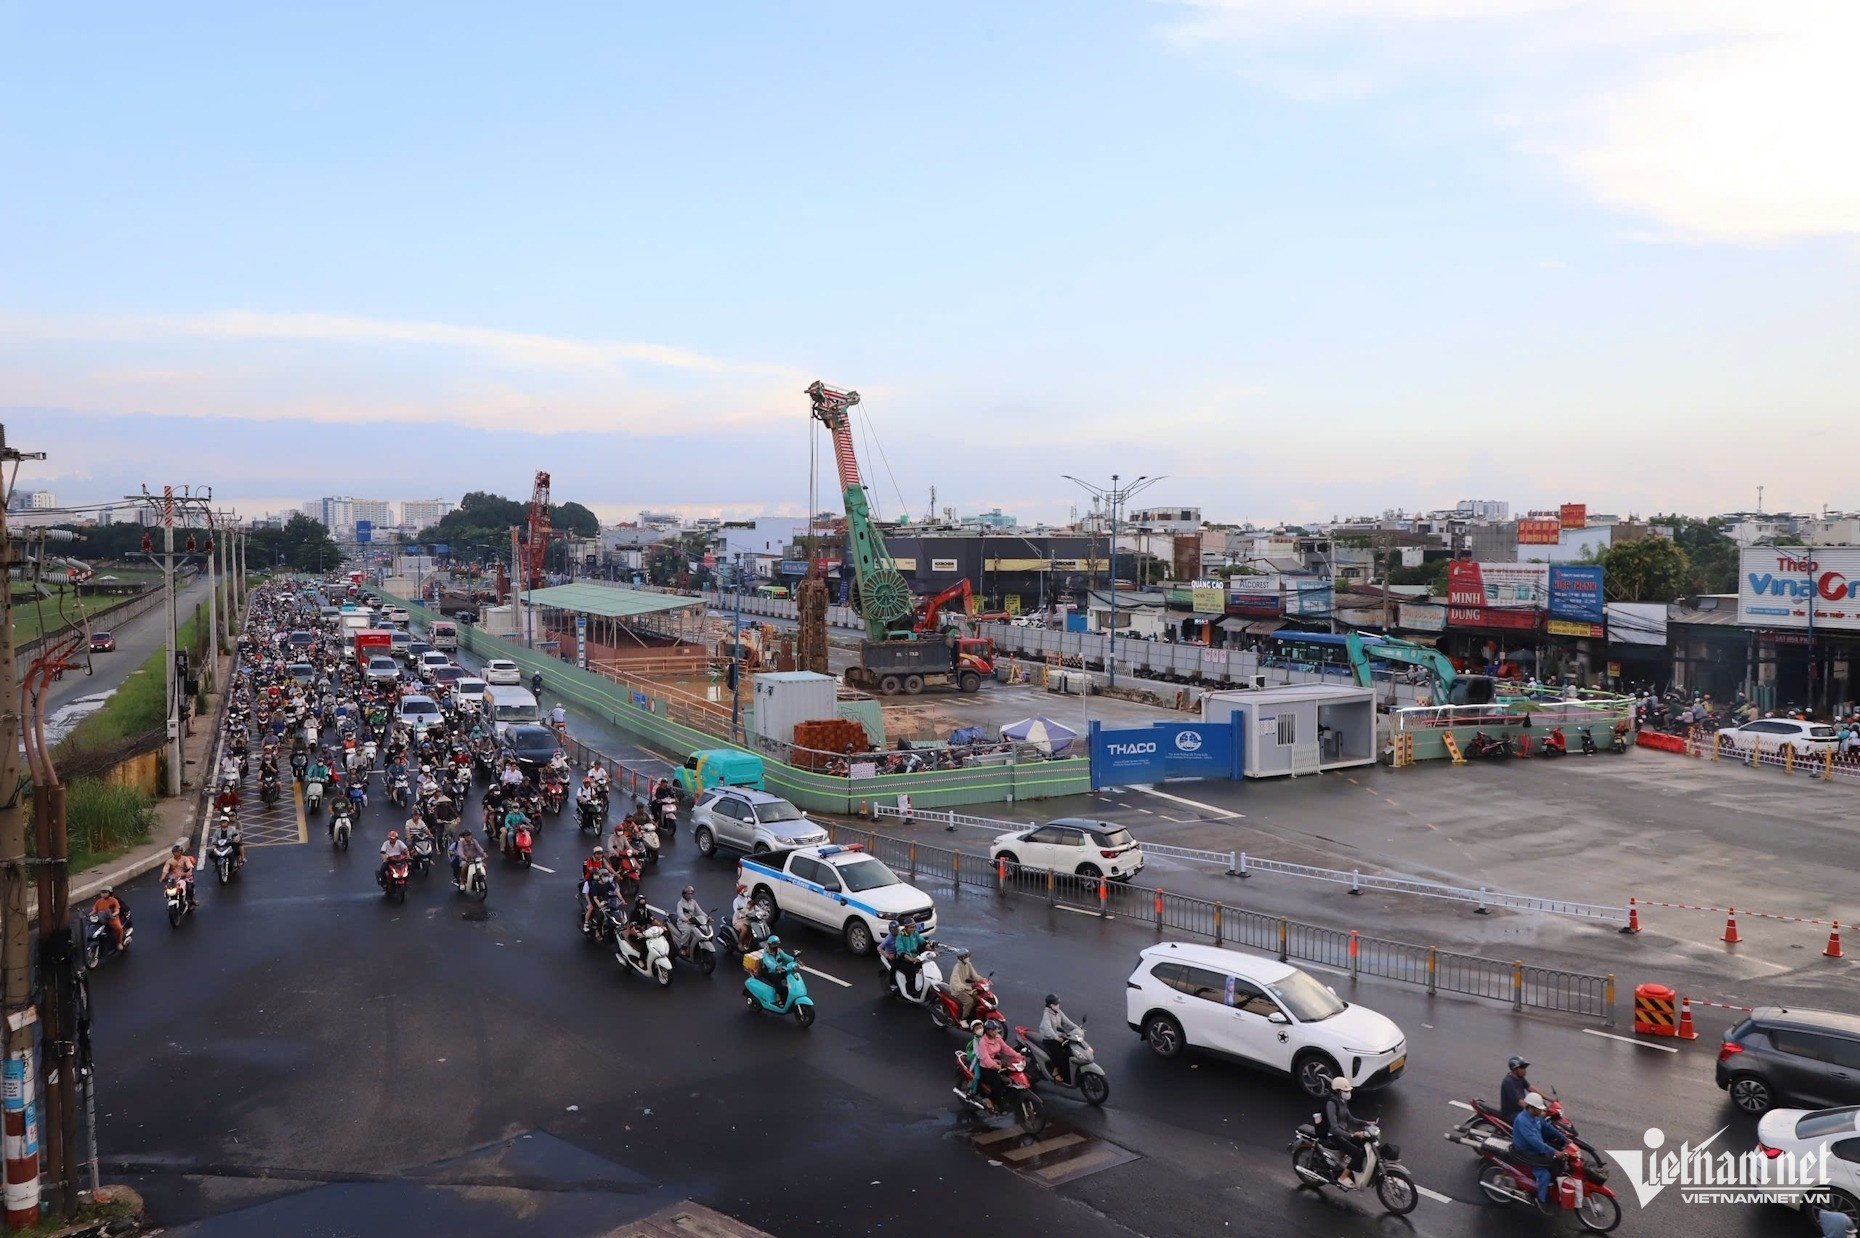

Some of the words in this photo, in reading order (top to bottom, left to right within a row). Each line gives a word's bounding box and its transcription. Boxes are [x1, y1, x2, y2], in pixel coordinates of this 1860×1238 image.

[1777, 555, 1818, 575] Thép
[1451, 592, 1481, 604] MINH
[1107, 742, 1157, 755] THACO
